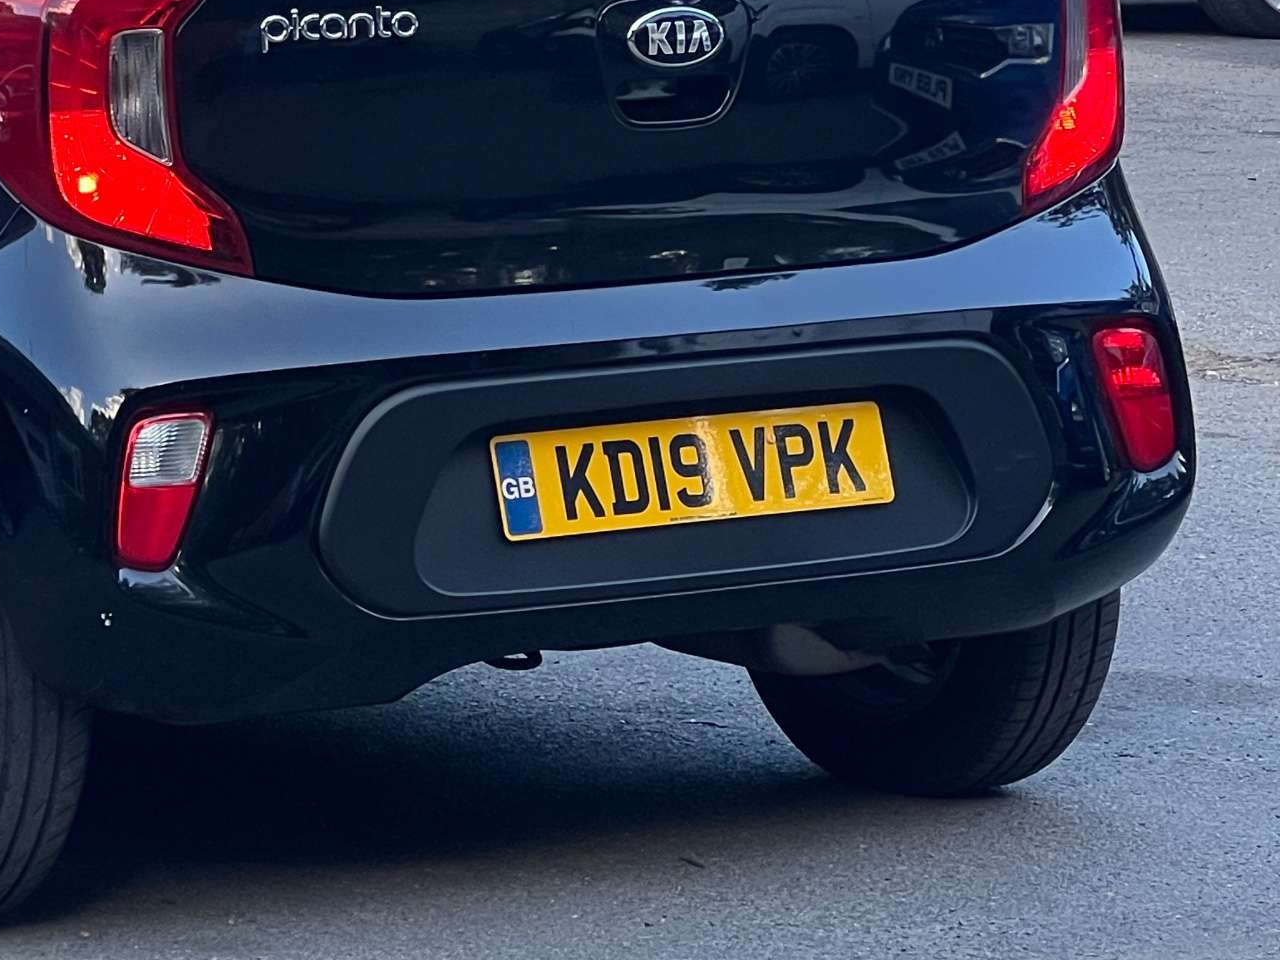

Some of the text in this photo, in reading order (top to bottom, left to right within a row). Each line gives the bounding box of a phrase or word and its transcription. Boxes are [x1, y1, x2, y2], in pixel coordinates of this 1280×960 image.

[260, 5, 419, 54] picanto
[645, 19, 713, 56] KIA
[500, 476, 536, 501] GB
[555, 418, 867, 521] KD19 VPK
